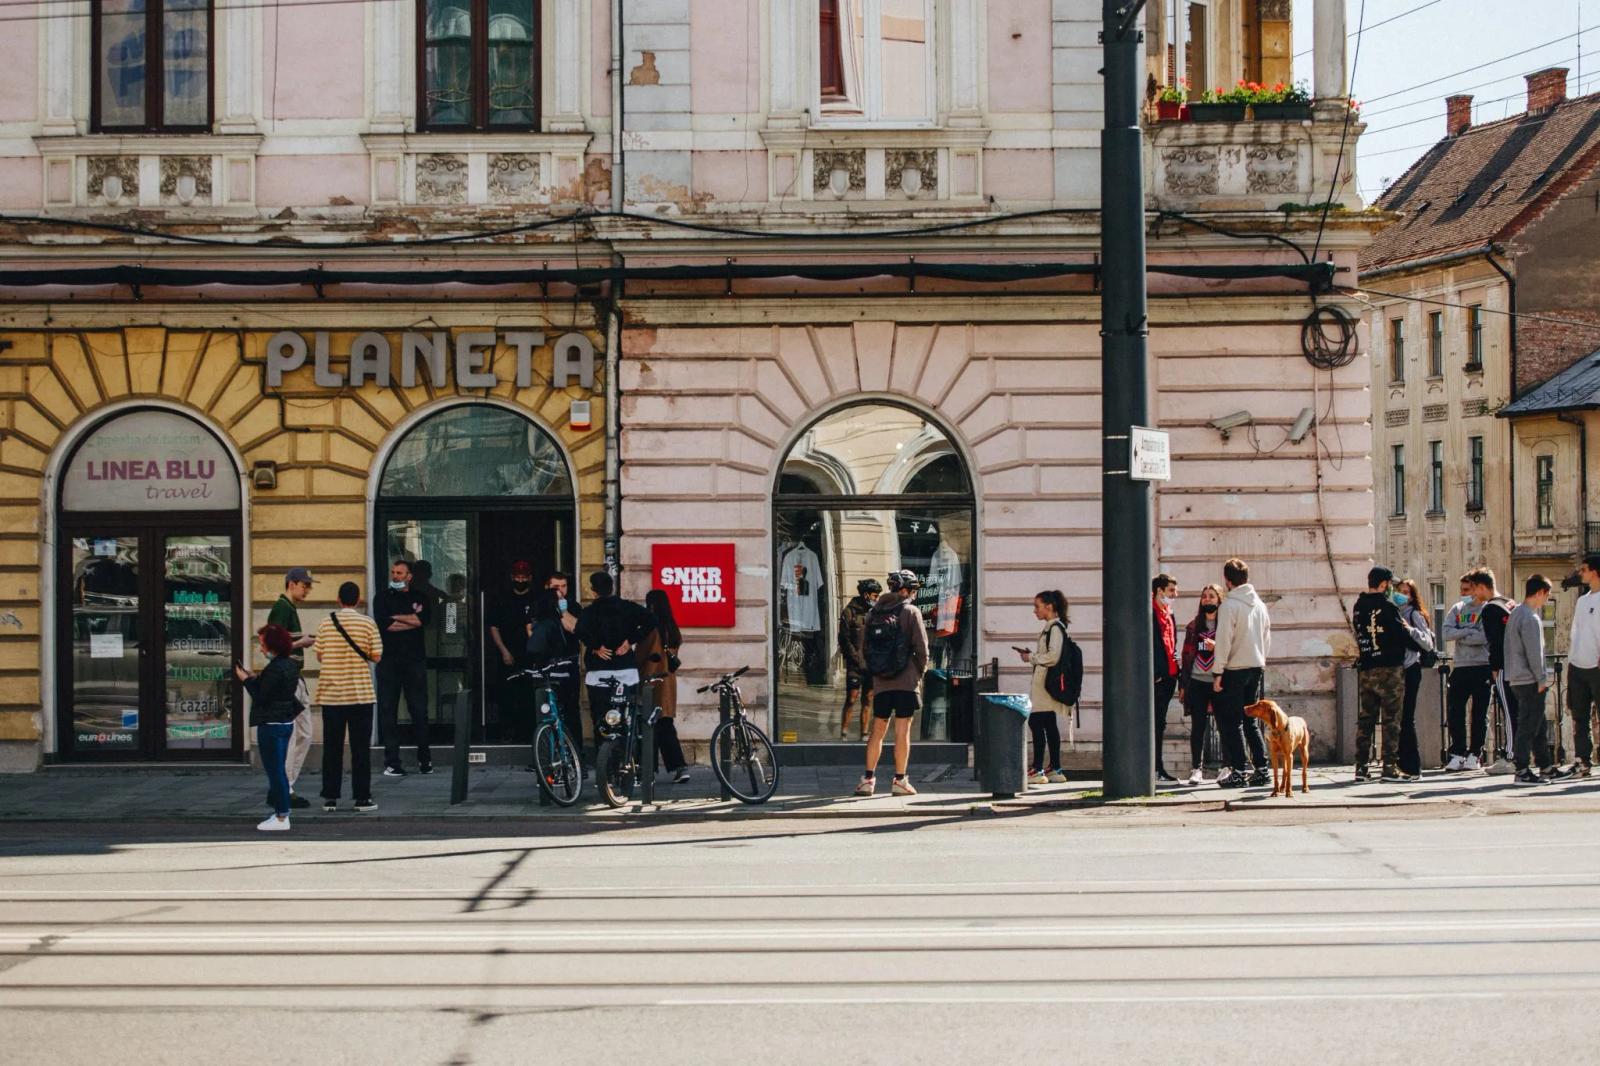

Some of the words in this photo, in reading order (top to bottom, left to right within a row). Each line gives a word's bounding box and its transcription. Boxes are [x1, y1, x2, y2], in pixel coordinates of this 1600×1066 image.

[266, 330, 595, 388] PLANETA
[87, 461, 161, 480] LINEA
[166, 459, 216, 480] BLU
[146, 483, 212, 499] travel
[660, 566, 722, 585] SNKR
[681, 585, 727, 603] IND.
[173, 666, 224, 681] TURISM
